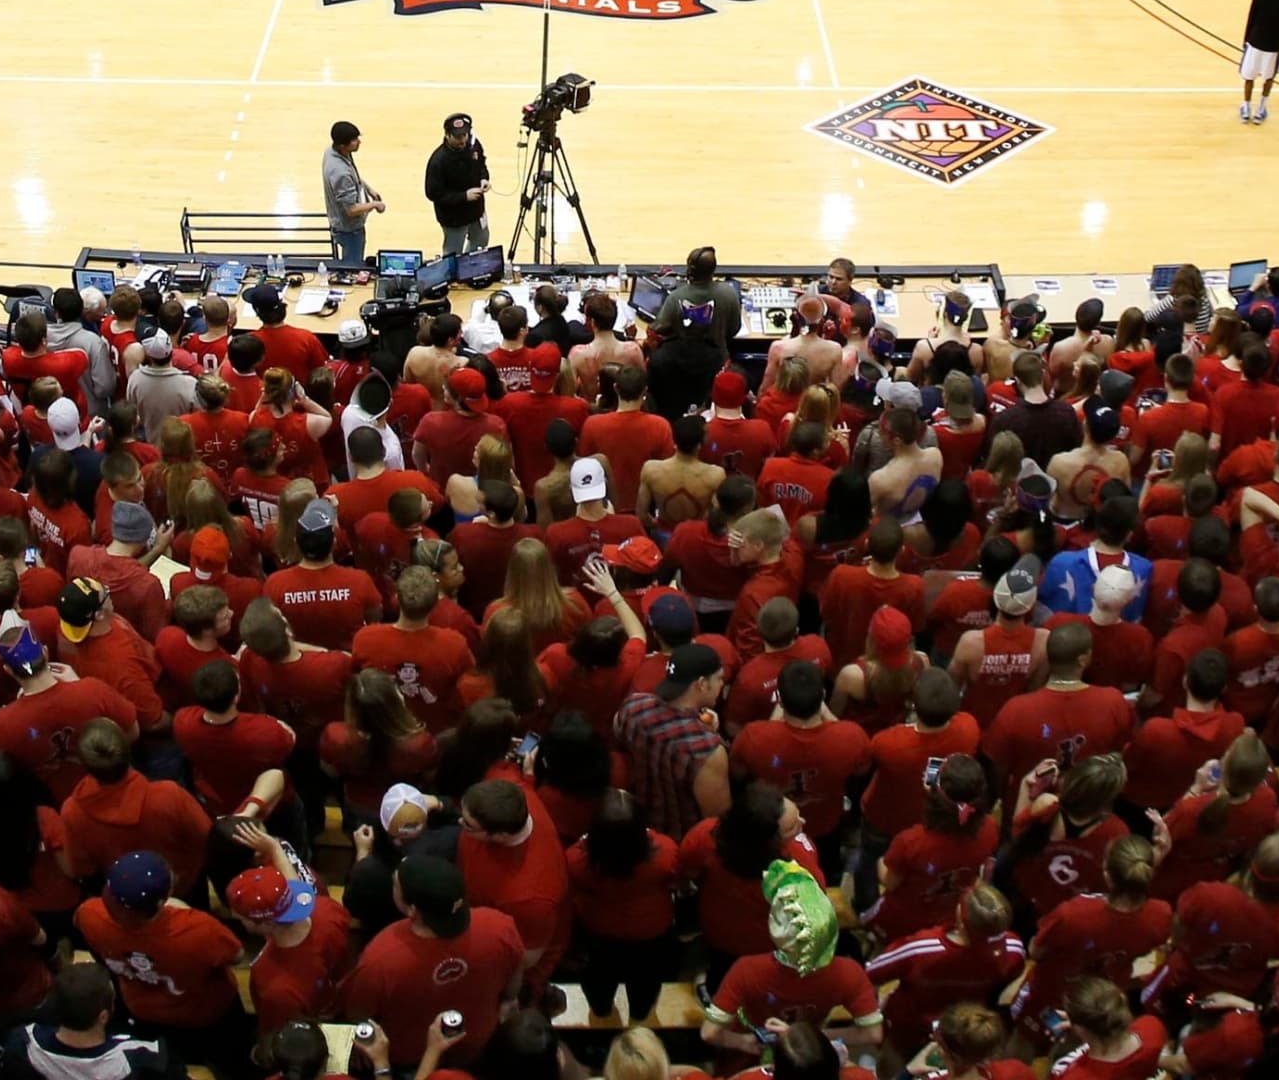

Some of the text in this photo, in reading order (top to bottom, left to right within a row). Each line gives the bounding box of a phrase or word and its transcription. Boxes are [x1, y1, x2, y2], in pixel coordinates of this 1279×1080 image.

[831, 83, 1030, 128] NATIONAL INVITATION
[870, 118, 1000, 142] NIT
[832, 129, 1033, 177] TOURNAMENT NEW YORK
[284, 588, 351, 604] EVENT STAFF
